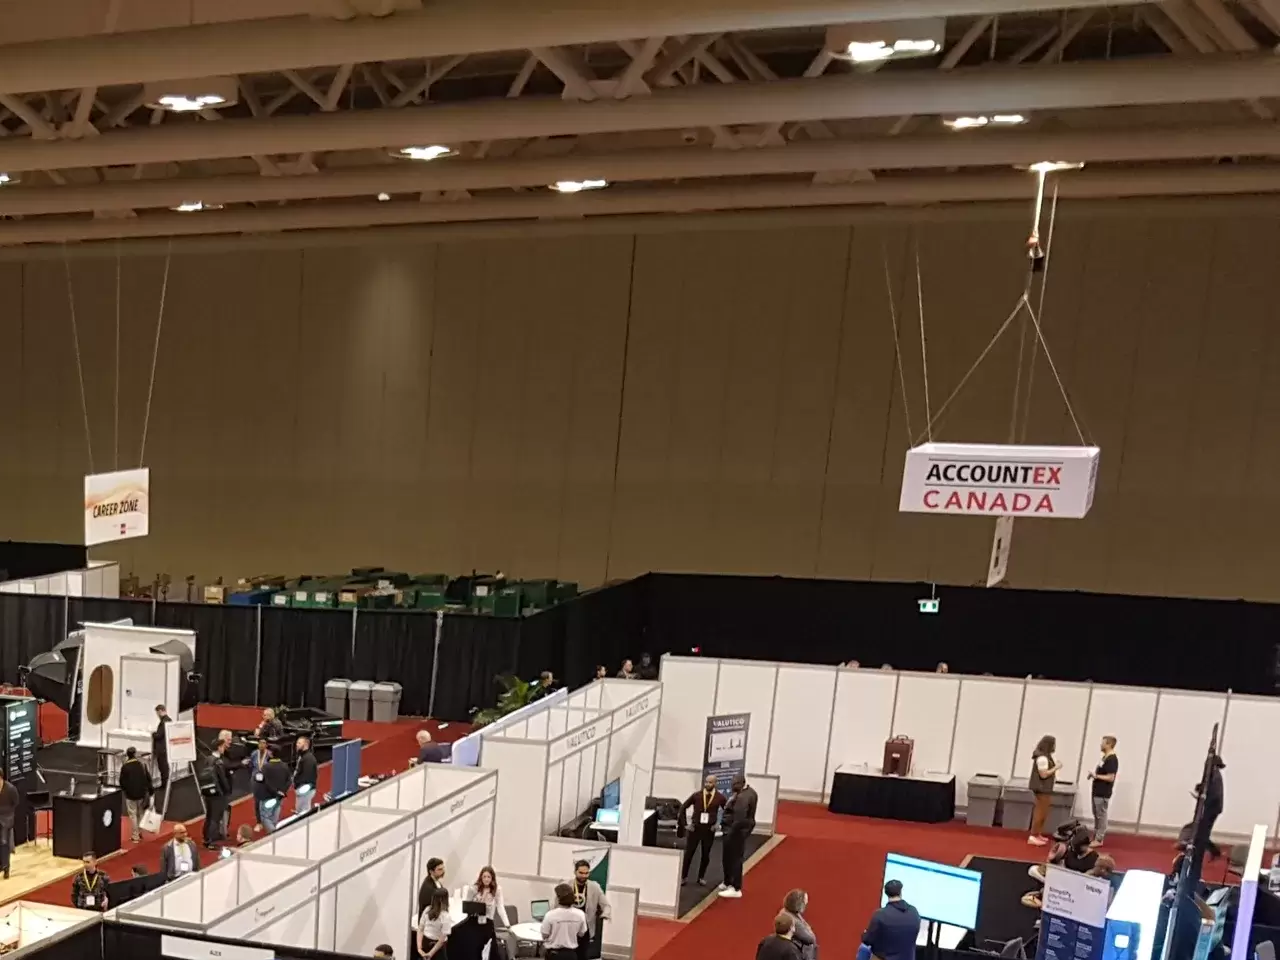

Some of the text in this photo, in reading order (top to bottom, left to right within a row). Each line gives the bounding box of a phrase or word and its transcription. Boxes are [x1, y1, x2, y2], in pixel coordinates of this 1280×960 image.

[926, 463, 1062, 485] ACCOUNTEX
[93, 499, 139, 518] CAREER ZONE
[923, 490, 1054, 513] CANADA
[713, 718, 745, 727] VALUTICO
